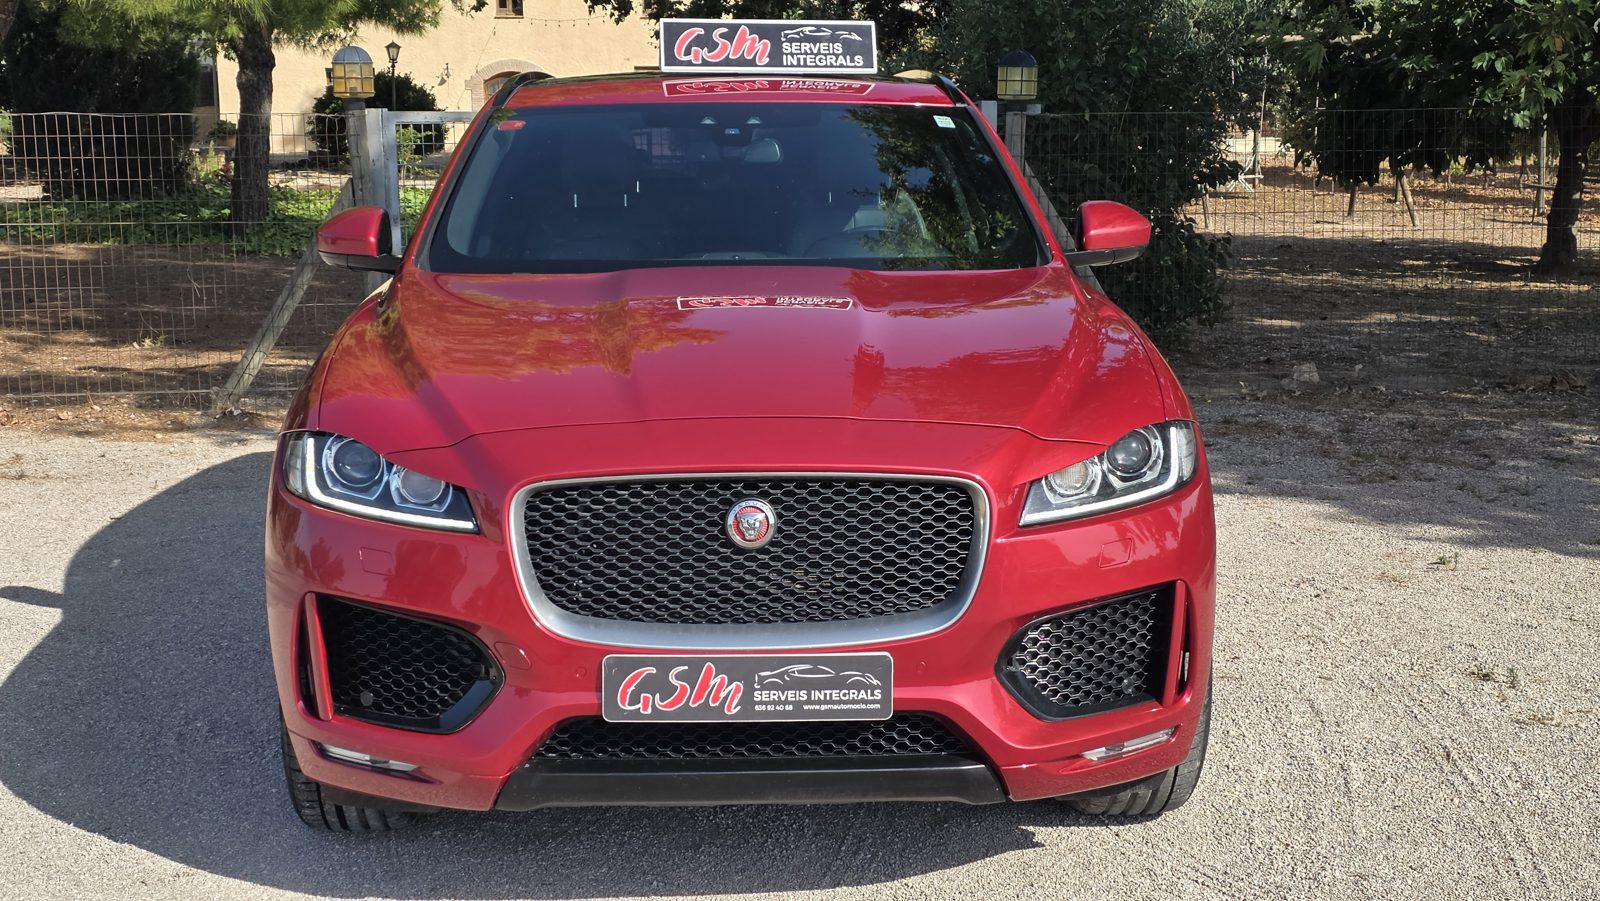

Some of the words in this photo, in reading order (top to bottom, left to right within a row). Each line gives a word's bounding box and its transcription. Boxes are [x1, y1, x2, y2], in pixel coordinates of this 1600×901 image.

[782, 42, 843, 54] SERVEIS
[782, 54, 864, 67] INTEGRALS
[753, 690, 808, 702] SERVEIS
[811, 688, 882, 701] INTEGRALS
